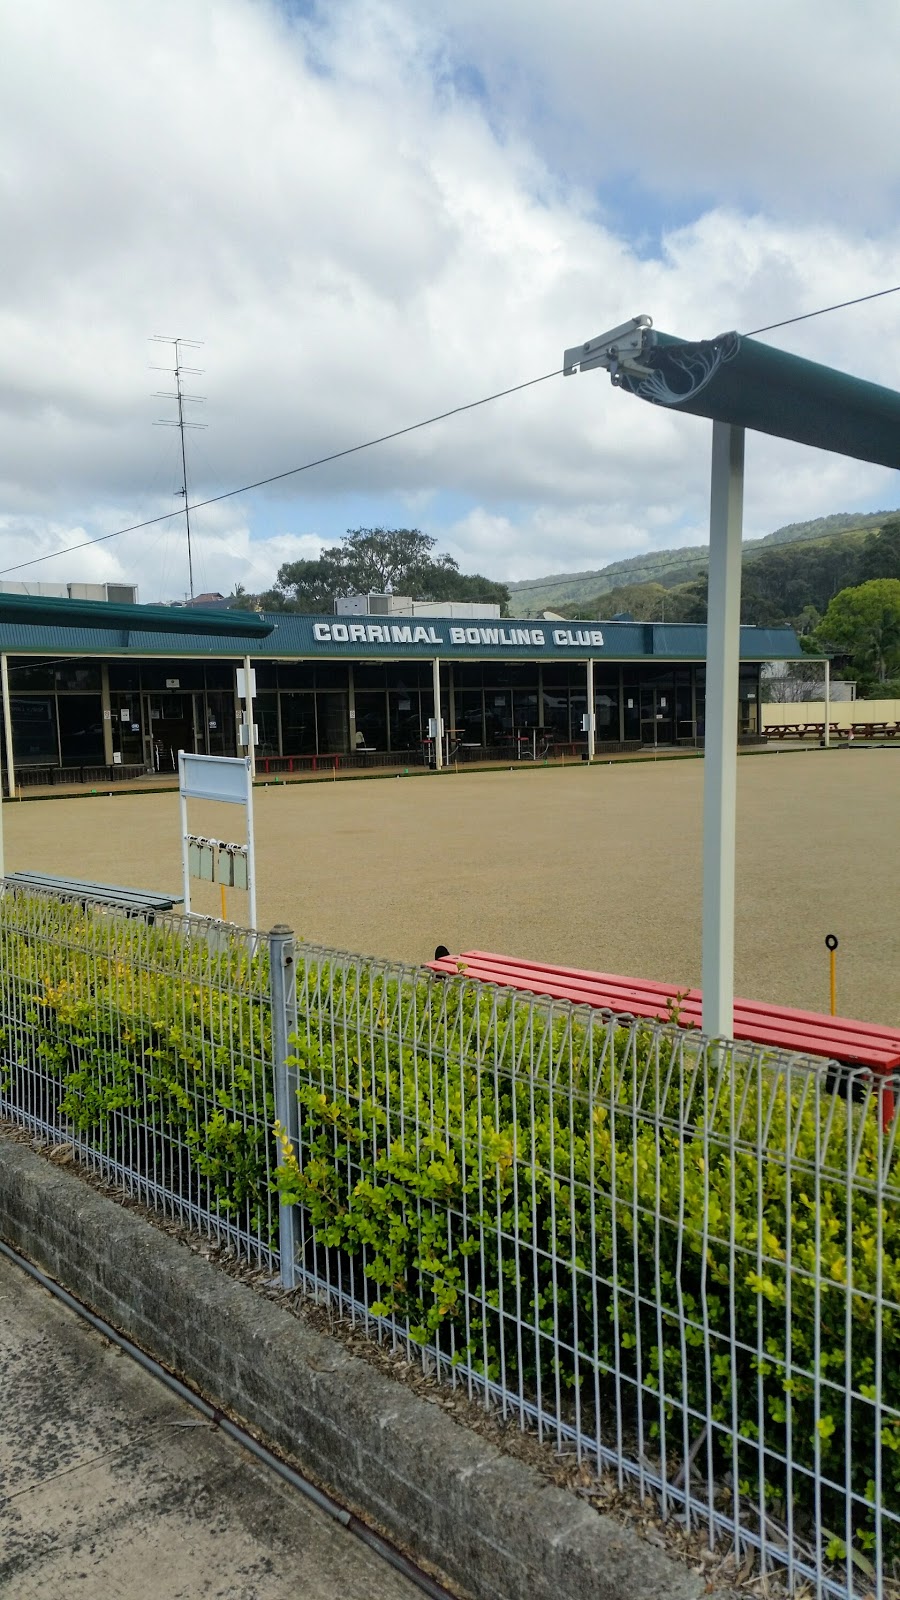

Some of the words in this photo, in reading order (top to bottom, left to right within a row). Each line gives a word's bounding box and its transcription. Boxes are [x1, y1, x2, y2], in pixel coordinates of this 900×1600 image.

[313, 623, 443, 644] CORRIMAL
[449, 627, 545, 646] BOWLING
[552, 630, 604, 647] CLUB
